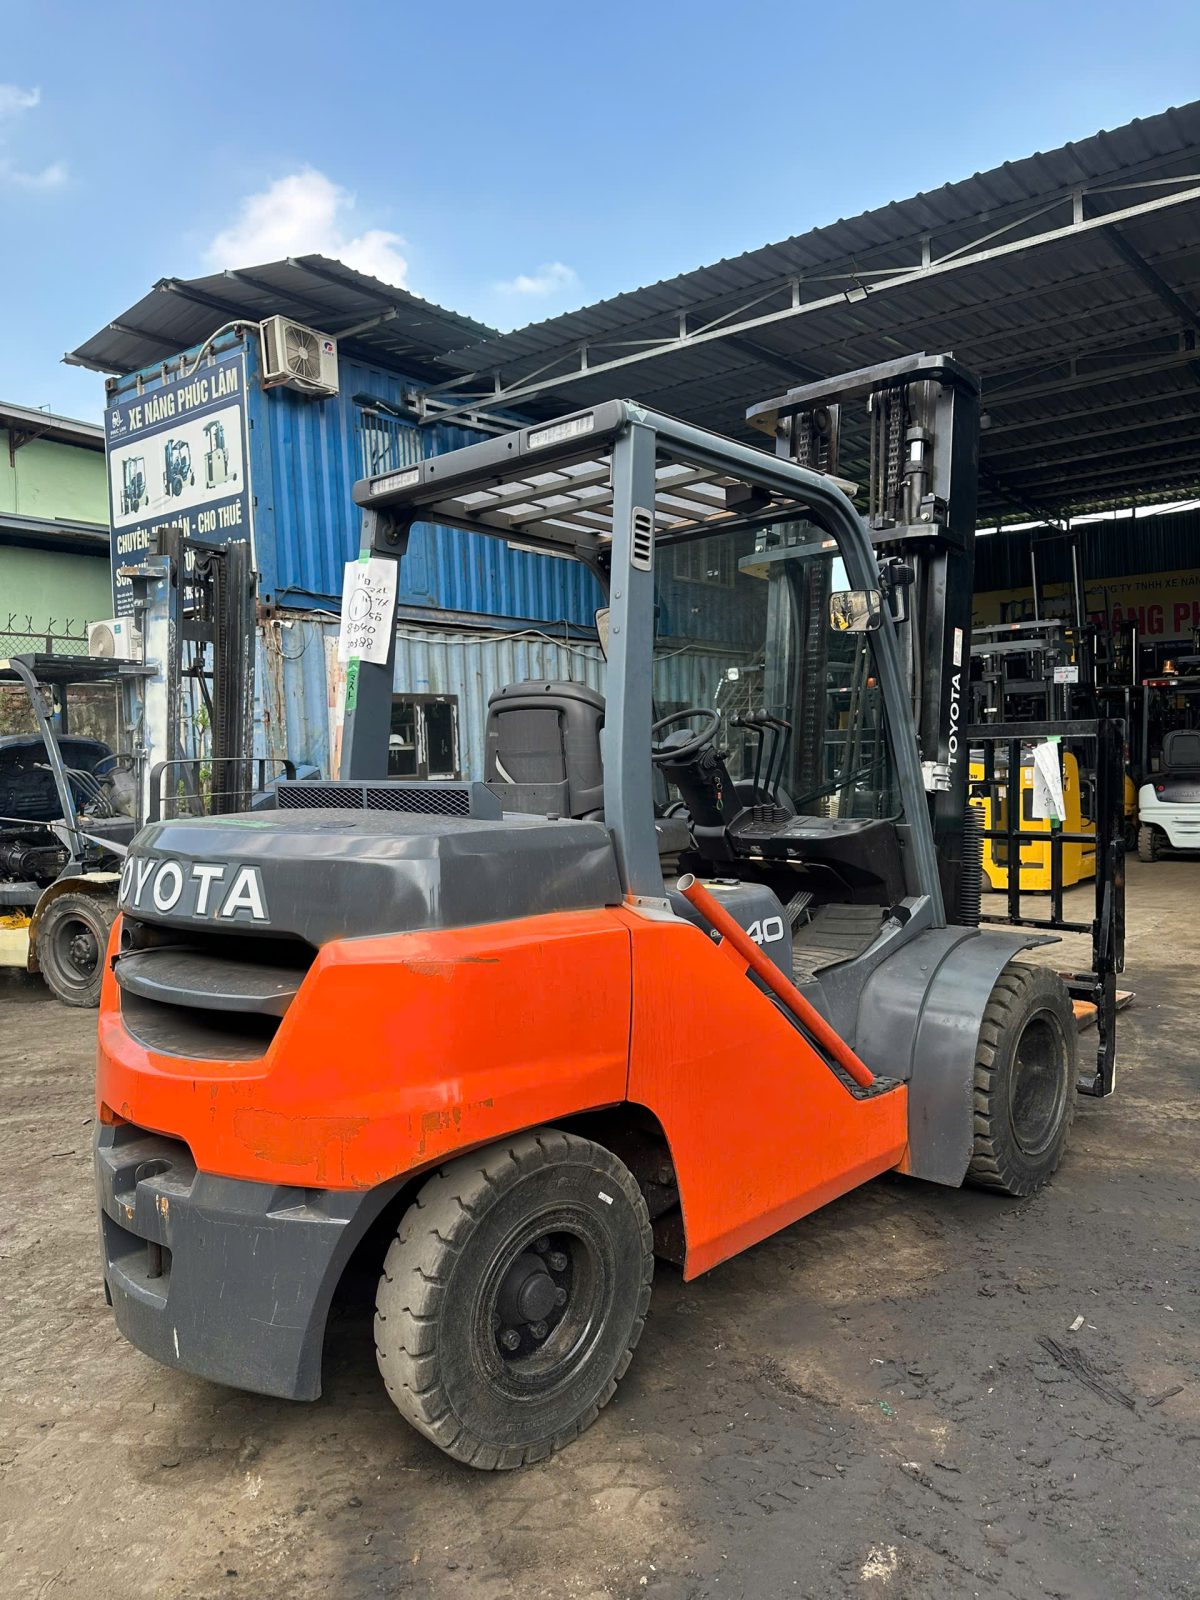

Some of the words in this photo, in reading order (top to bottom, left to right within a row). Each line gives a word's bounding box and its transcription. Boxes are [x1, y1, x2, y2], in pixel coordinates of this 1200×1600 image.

[128, 406, 143, 431] XE
[144, 393, 175, 425] NÂNG
[177, 377, 209, 412] PHÚC
[211, 367, 238, 399] LÂM
[117, 526, 150, 555] CHUYÊN:
[198, 510, 216, 534] CHO
[218, 499, 242, 528] THUÊ
[1135, 580, 1162, 591] TNHH
[1165, 578, 1177, 588] XE
[948, 673, 961, 766] TOYOTA
[746, 915, 784, 945] 40
